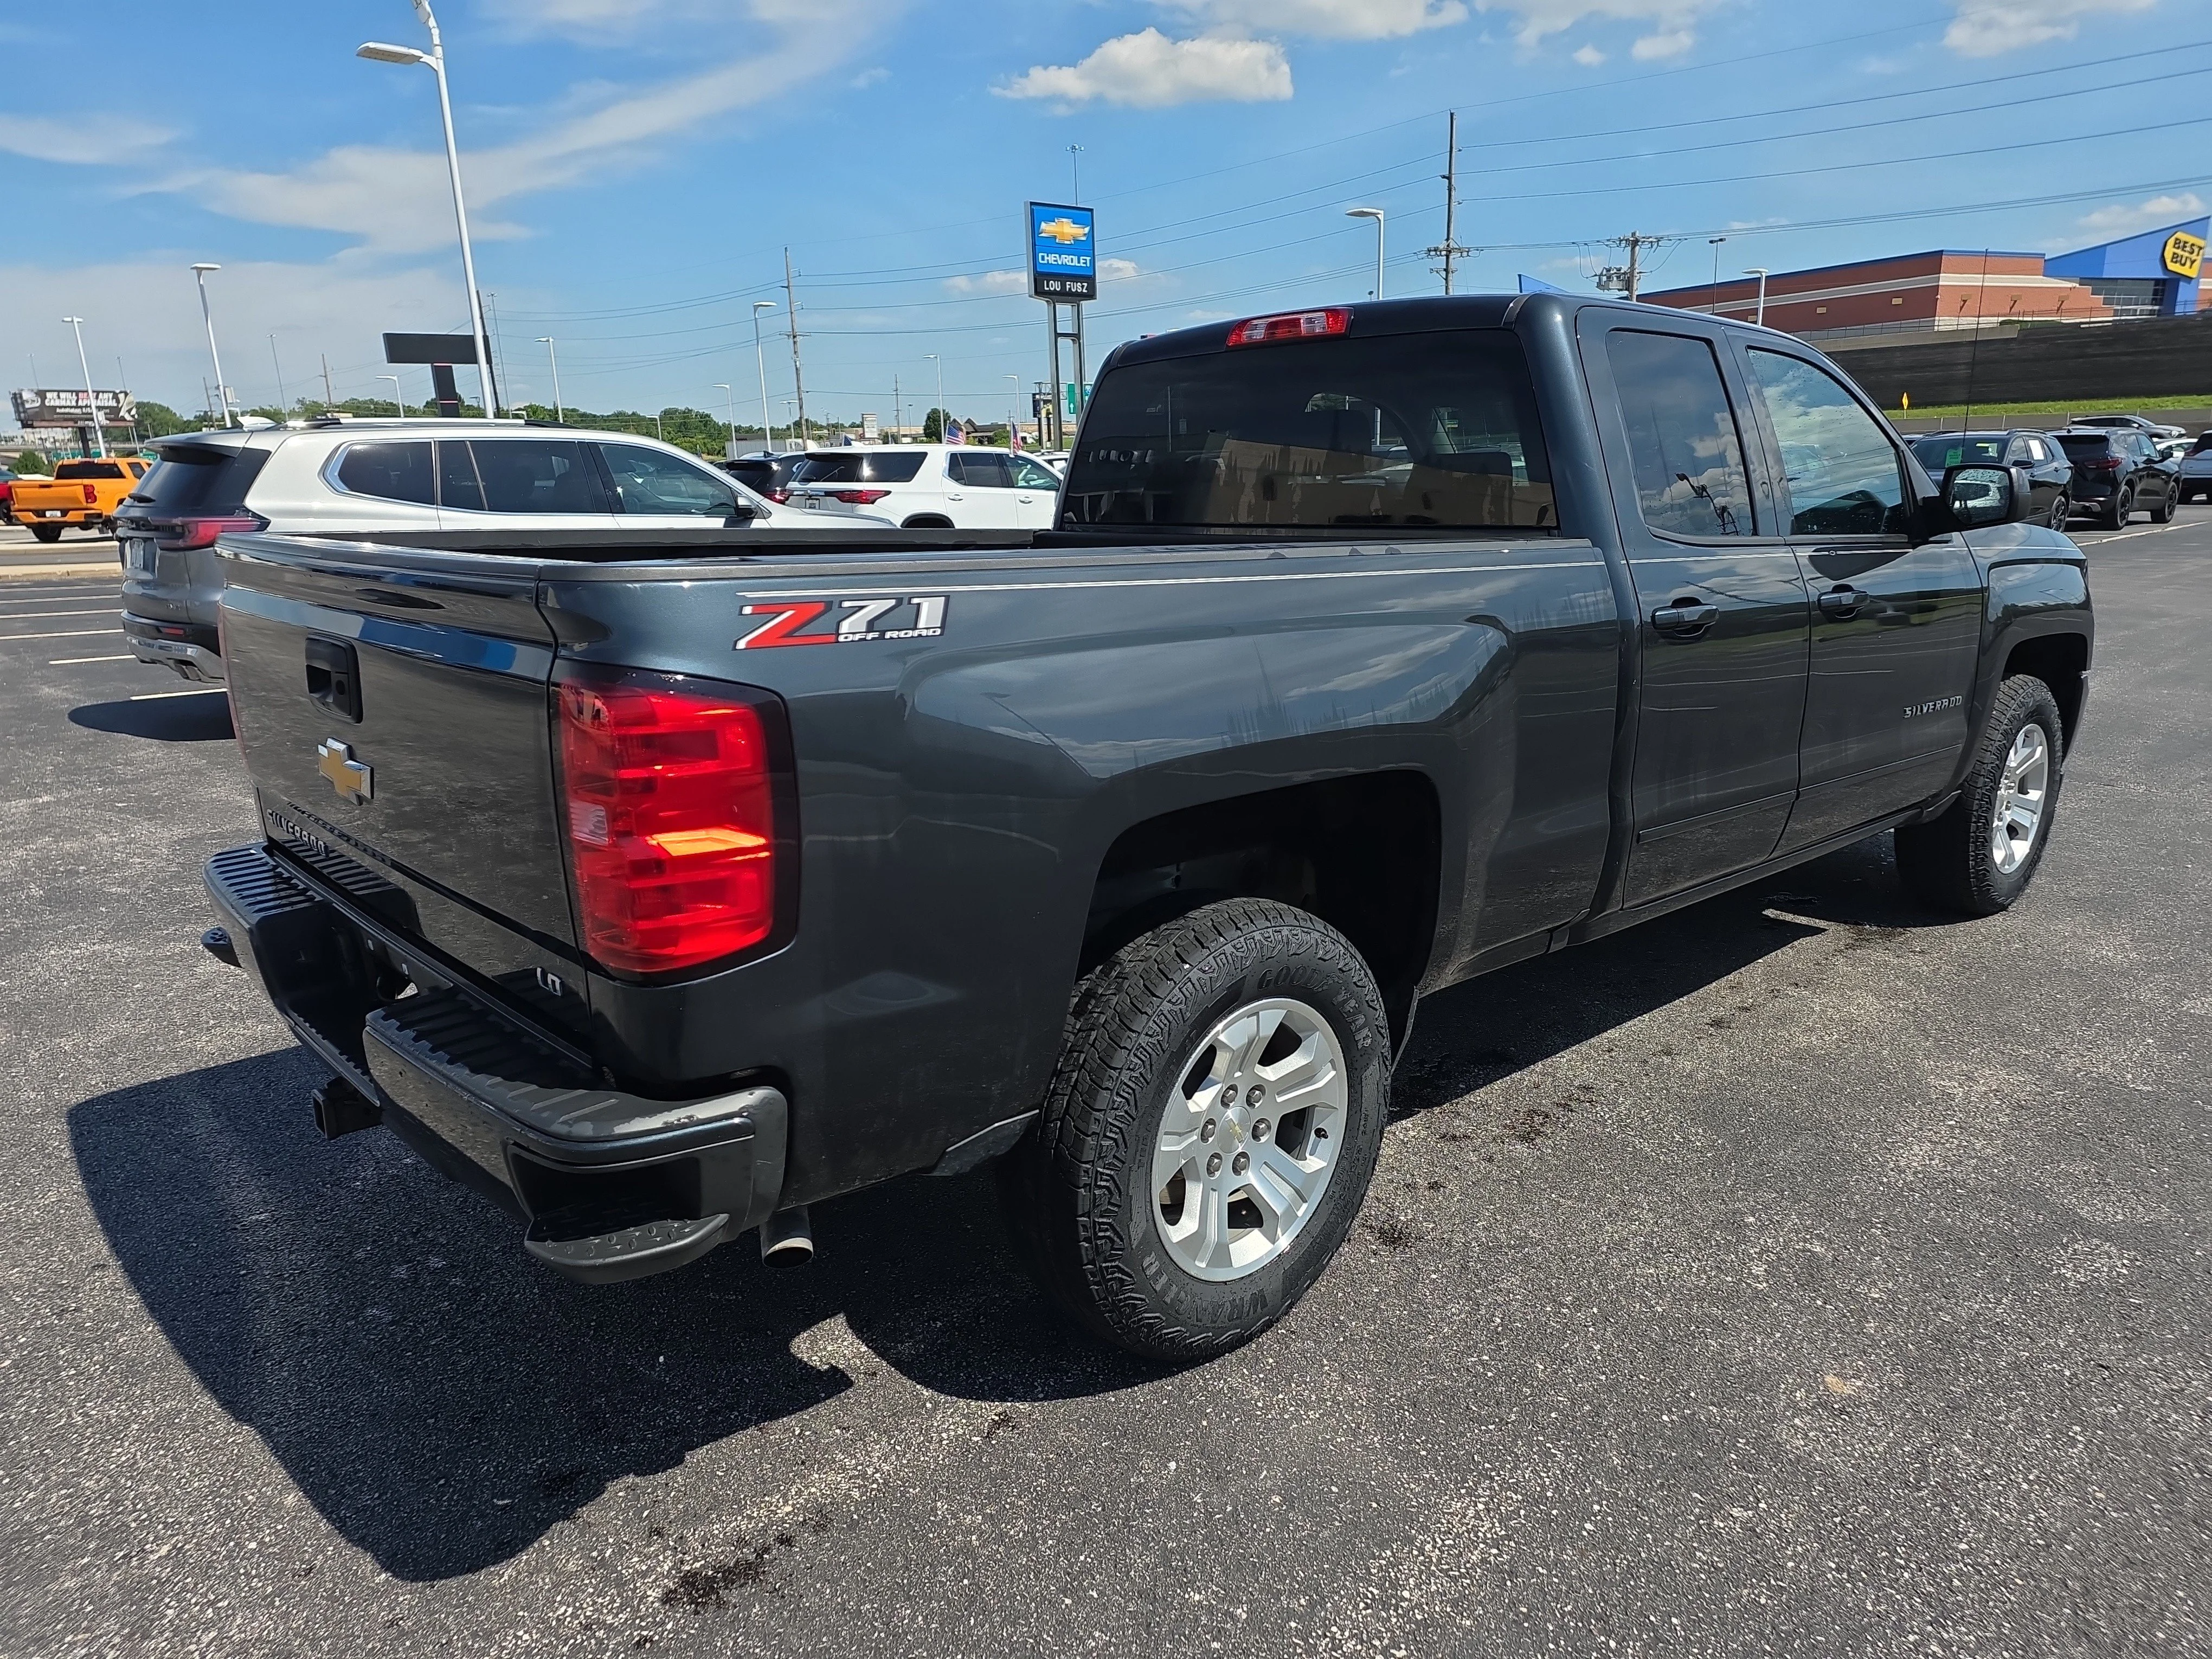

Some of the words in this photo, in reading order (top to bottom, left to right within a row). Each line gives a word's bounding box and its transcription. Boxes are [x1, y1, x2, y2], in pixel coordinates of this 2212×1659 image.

[2173, 237, 2203, 256] BEST
[1038, 253, 1091, 267] CHEVROLET
[2171, 252, 2197, 269] BUY
[1044, 280, 1061, 291] LOU
[1066, 281, 1088, 293] FUSZ
[45, 398, 76, 406] CARMAX
[733, 595, 950, 650] Z71
[838, 633, 880, 642] OFF
[884, 628, 941, 639] ROAD
[1903, 695, 1963, 719] SILVERADO
[267, 808, 326, 857] SILVERADO
[537, 967, 561, 996] LD
